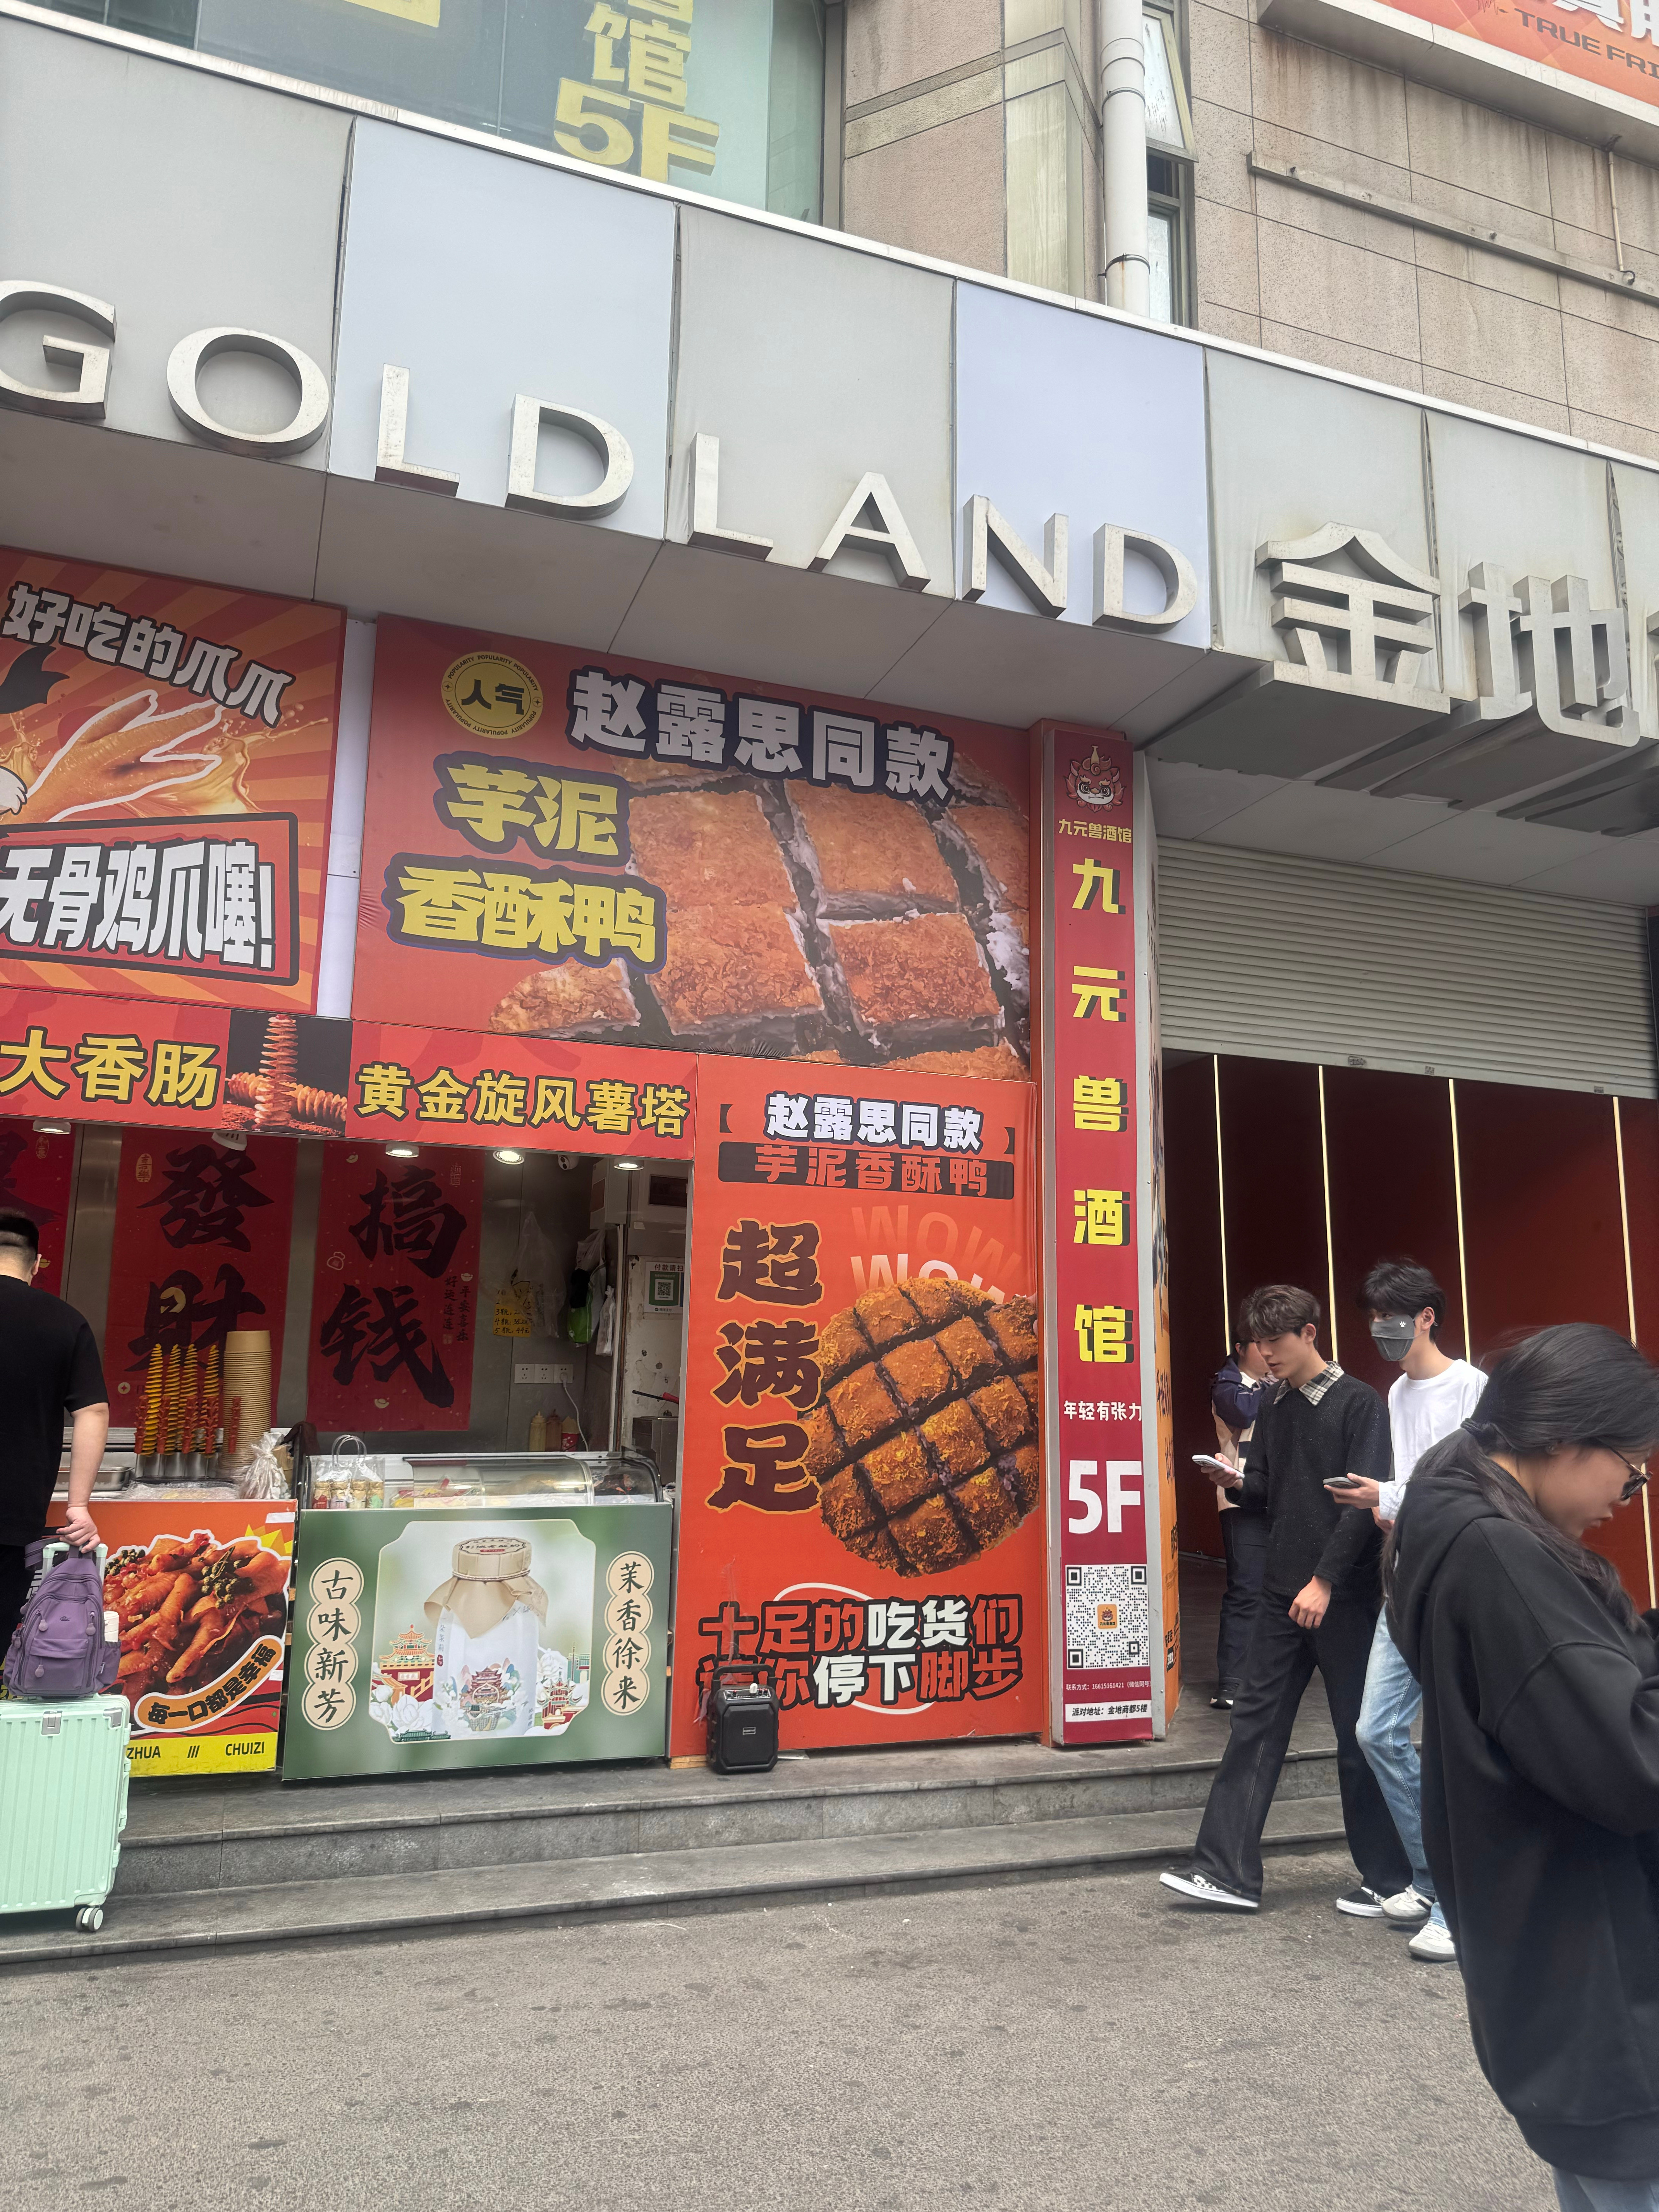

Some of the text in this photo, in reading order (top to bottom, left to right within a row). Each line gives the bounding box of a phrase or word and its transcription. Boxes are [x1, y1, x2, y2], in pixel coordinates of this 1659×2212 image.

[1514, 8, 1601, 55] TRUE
[554, 77, 719, 183] 5F
[3, 584, 292, 725] 好吃的爪爪
[477, 655, 512, 665] POPULARITY
[1255, 521, 1659, 747] 金地
[448, 657, 474, 679] POPULARITY
[461, 679, 524, 715] 人气
[514, 663, 539, 691] POPULARITY
[445, 699, 472, 727] POPULARITY
[473, 725, 508, 735] POPULARITY
[511, 711, 537, 733] POPULARITY
[572, 670, 952, 800] 赵露思同款
[446, 763, 620, 857] 芋泥
[1058, 819, 1132, 844] 九元兽酒馆
[396, 865, 656, 962] 香酥鸭
[0, 1029, 218, 1108] 大香肠
[358, 1064, 689, 1136] 黄金旋风薯塔
[755, 1144, 987, 1197] 芋泥香酥鸭
[852, 1205, 1022, 1276] WOW
[1064, 1400, 1142, 1422] 年轻有张力
[1068, 1459, 1143, 1534] 5F
[313, 1570, 354, 1723] 古味新芳
[612, 1561, 644, 1710] 茉香徐来
[702, 1596, 1020, 1655] 十足的吃货们
[148, 1643, 276, 1725] 每一口都是幸福
[225, 1741, 265, 1756] CHUIZI
